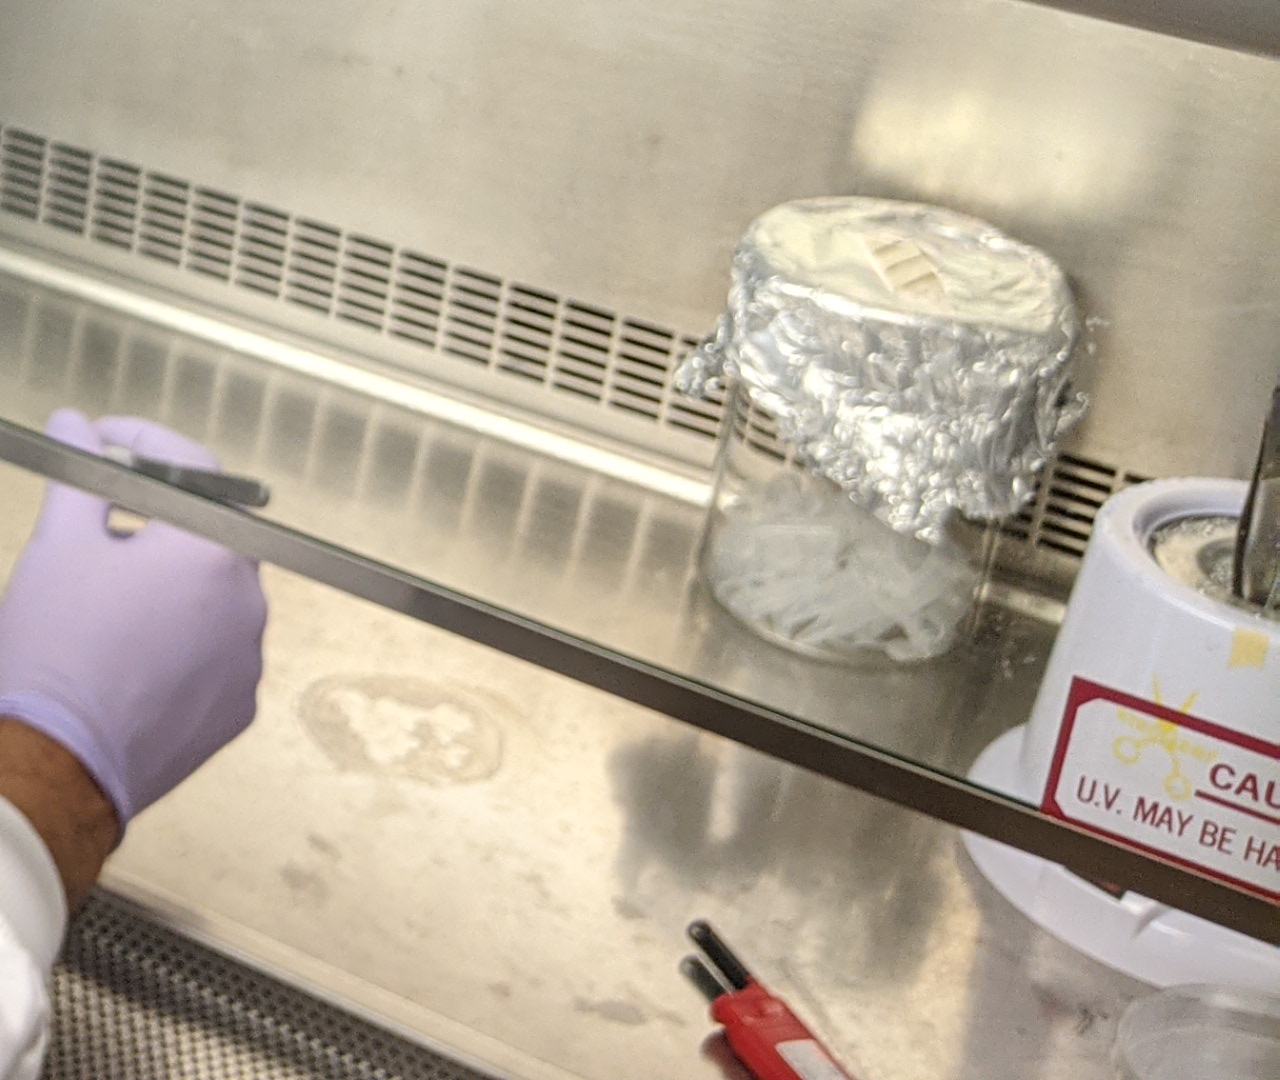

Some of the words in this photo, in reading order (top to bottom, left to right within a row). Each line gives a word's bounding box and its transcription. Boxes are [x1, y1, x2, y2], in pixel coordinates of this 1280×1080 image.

[1076, 775, 1123, 815] U.V.
[1133, 796, 1194, 838] MAY
[1198, 819, 1238, 856] BE
[1209, 763, 1280, 809] CAU
